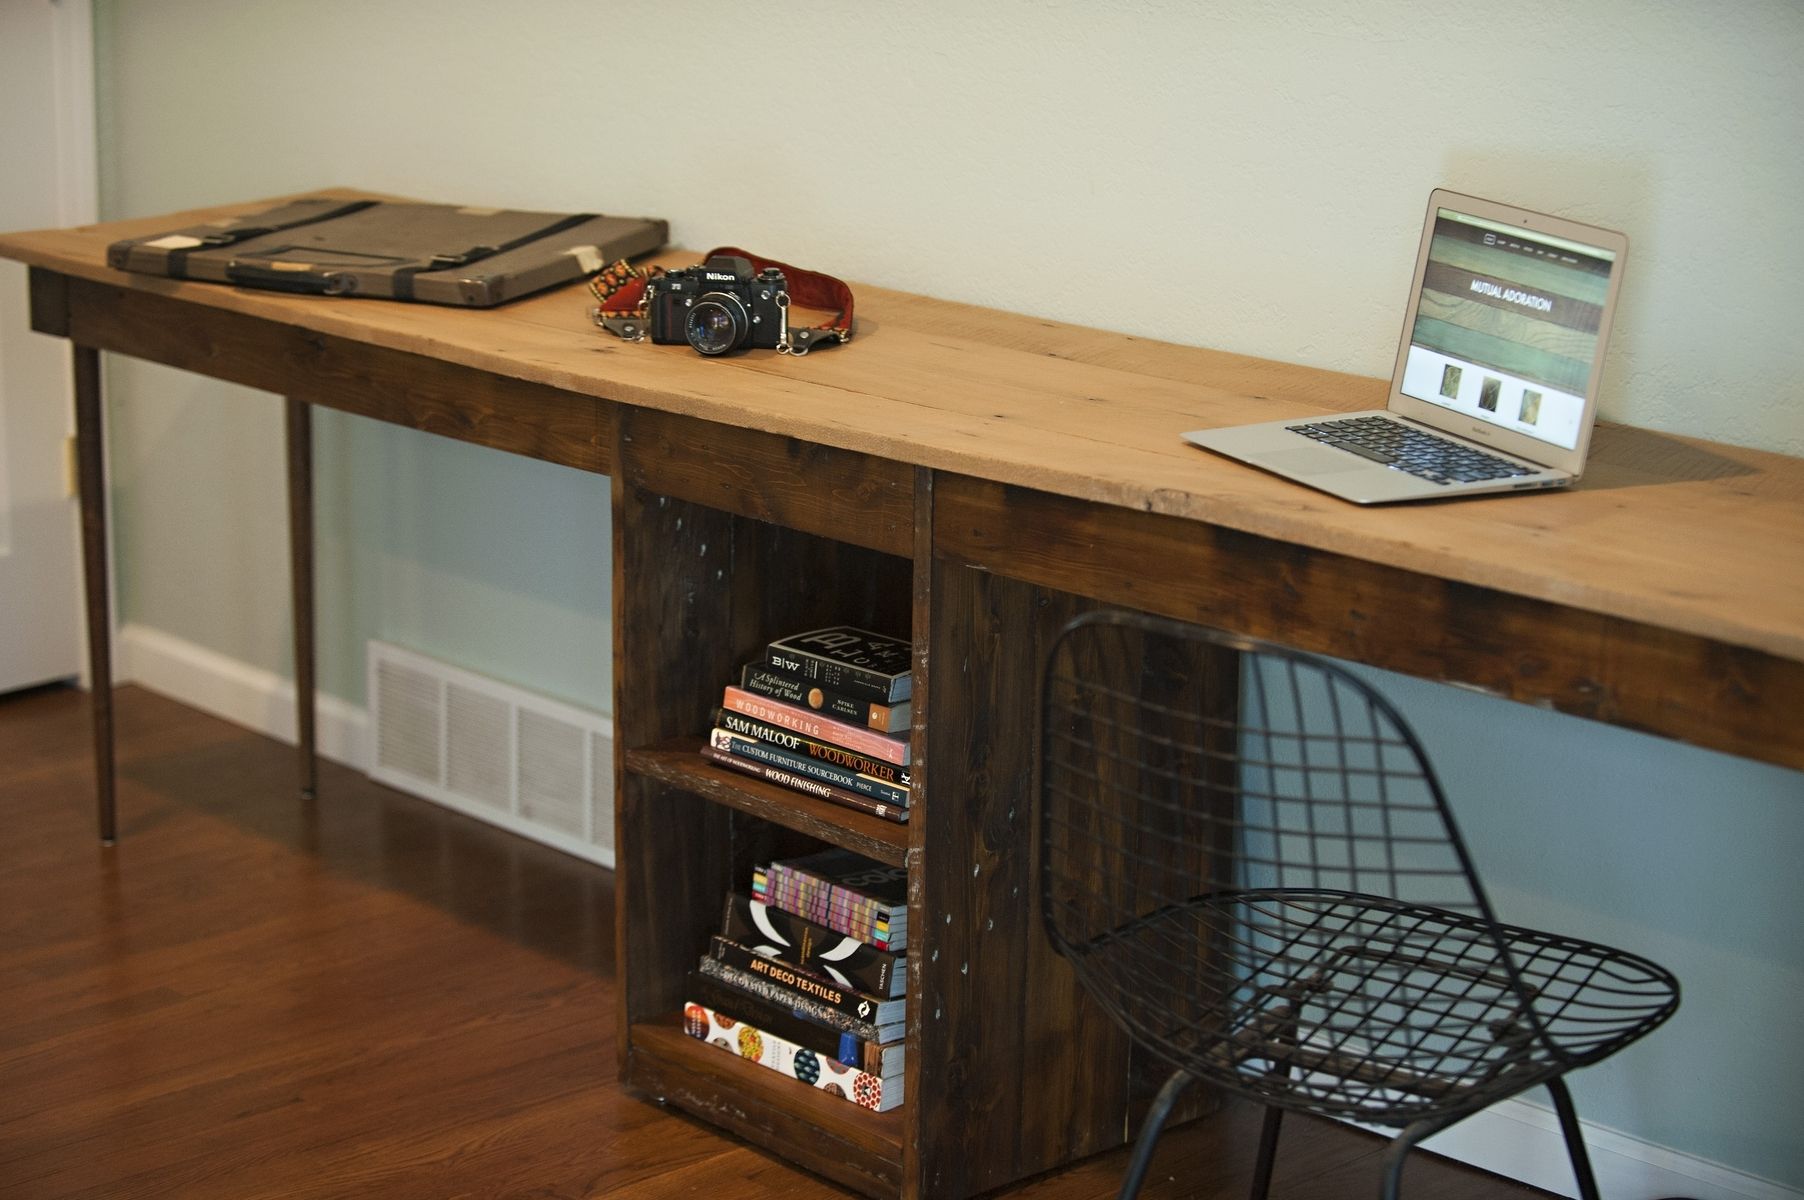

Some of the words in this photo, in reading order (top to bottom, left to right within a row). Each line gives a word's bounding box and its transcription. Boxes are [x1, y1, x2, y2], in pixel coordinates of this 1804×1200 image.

[706, 272, 735, 281] Nikon
[1470, 279, 1502, 298] MUTUAL
[1502, 288, 1552, 312] ADORATION
[749, 679, 774, 694] History
[775, 687, 783, 696] of
[784, 688, 802, 701] Wood
[754, 672, 766, 681] A
[765, 673, 800, 691] Splintered
[736, 698, 819, 735] WOODWORKING
[725, 716, 750, 734] SAM
[750, 724, 800, 749] MALOOF
[809, 743, 894, 781] WOODWORKER
[742, 745, 769, 760] CUSTOM
[769, 754, 807, 772] FURNITURE
[807, 765, 853, 787] SOURCEBOOK
[856, 781, 872, 792] PIERCE
[765, 768, 790, 784] WOOD
[790, 777, 831, 798] FINISHING
[750, 959, 769, 974] ART
[769, 966, 795, 985] DECO
[796, 977, 842, 1004] TEXTILES
[879, 963, 887, 990] TASCHEN
